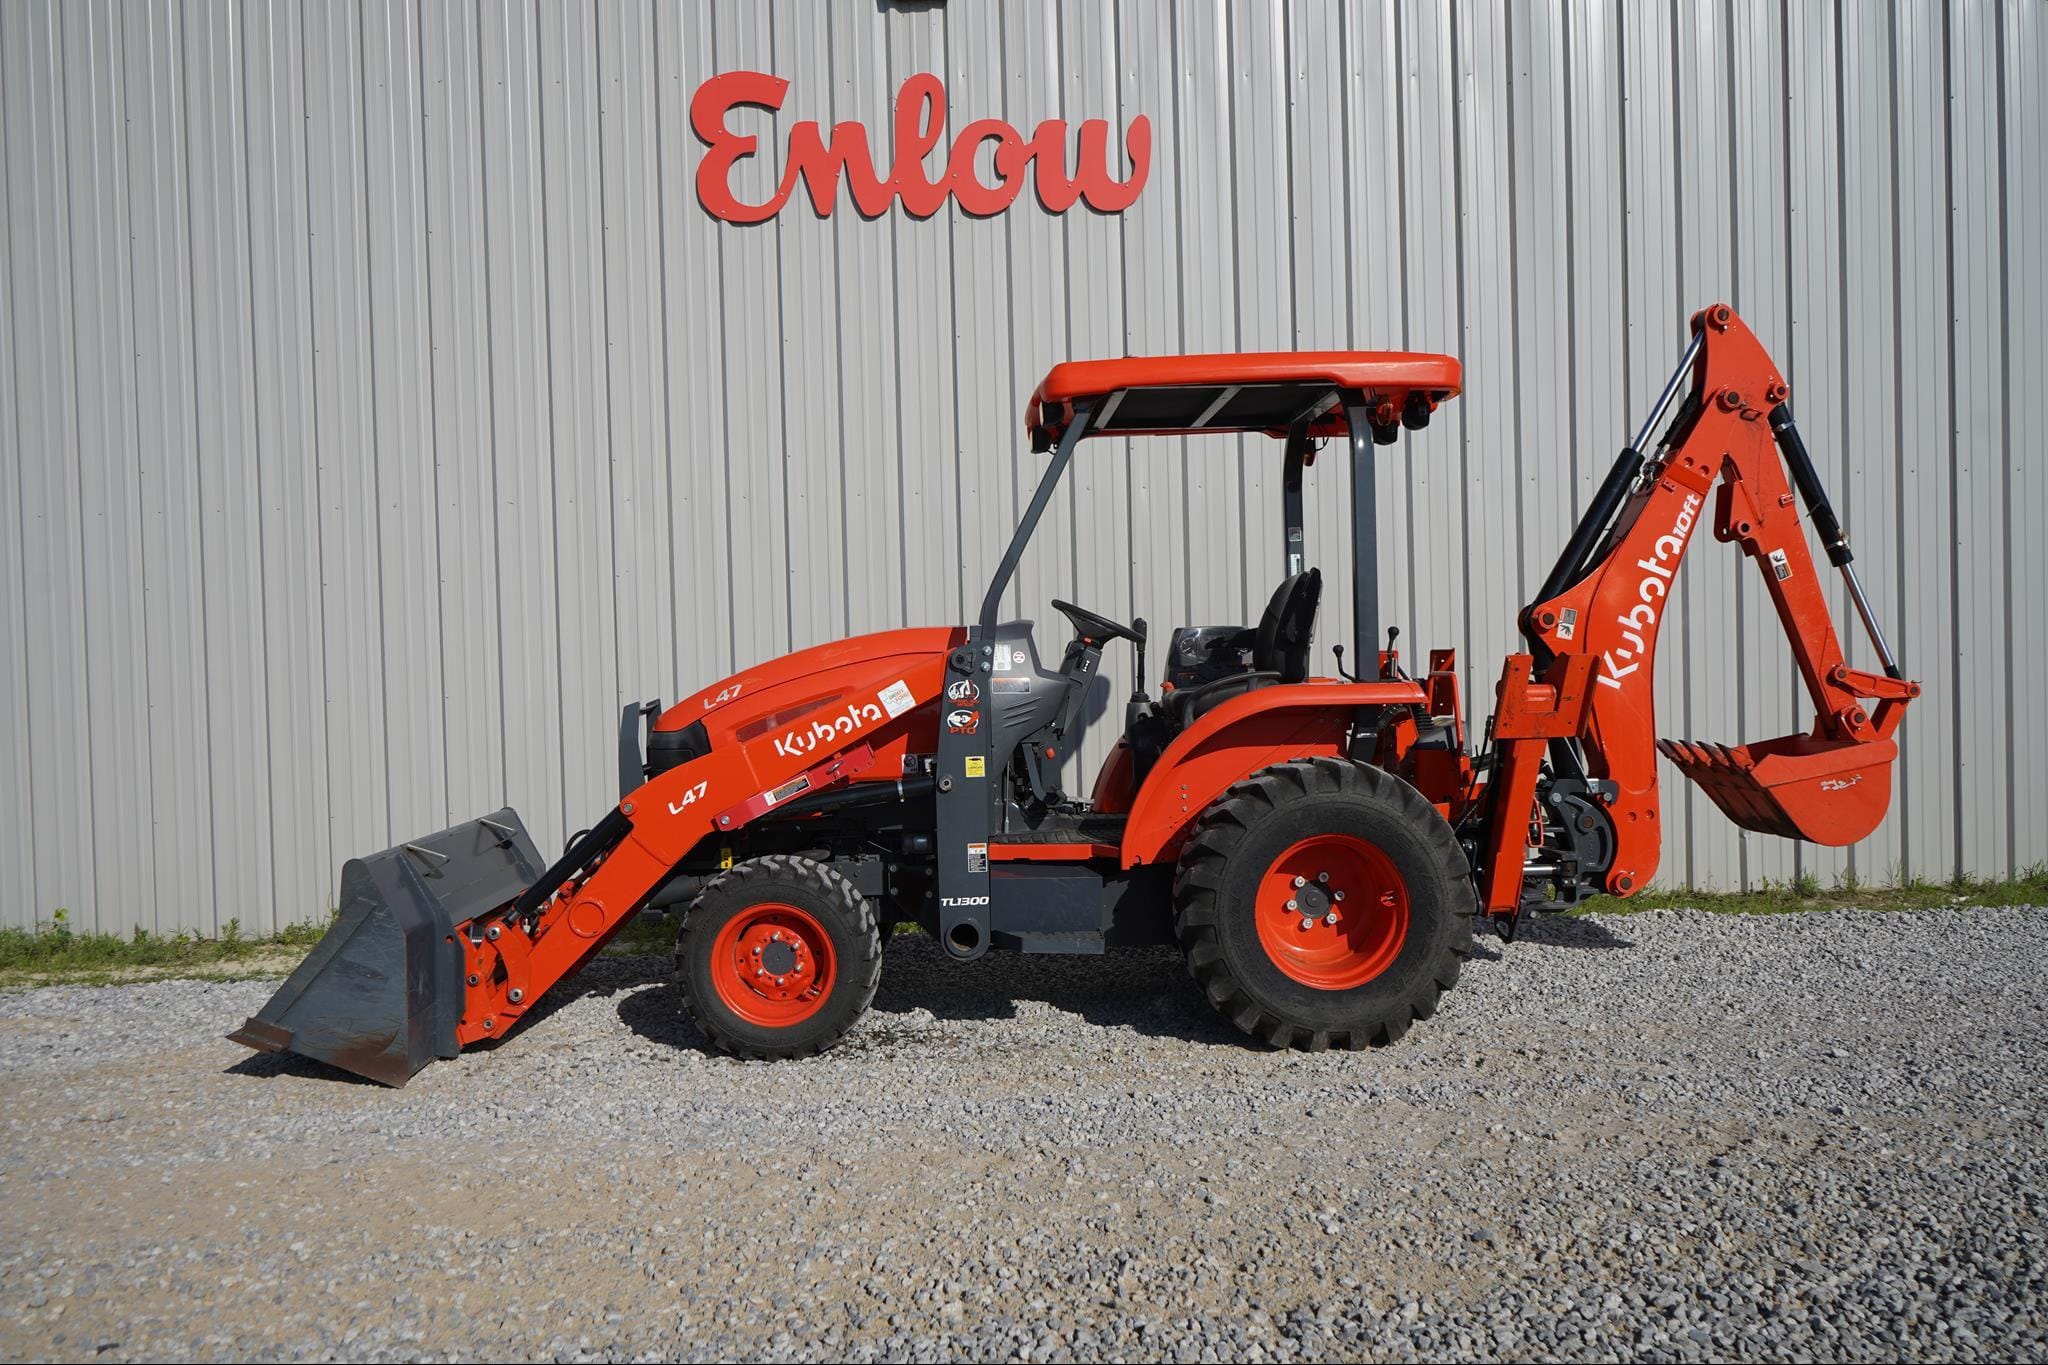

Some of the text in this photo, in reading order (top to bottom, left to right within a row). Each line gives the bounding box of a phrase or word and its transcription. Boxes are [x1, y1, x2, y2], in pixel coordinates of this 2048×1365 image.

[690, 71, 1151, 223] Enlow
[1597, 493, 1700, 689] Kubota 10ft
[703, 683, 742, 709] L47
[773, 703, 882, 756] Kubota
[949, 726, 976, 735] PTO
[668, 780, 707, 815] L47
[940, 896, 990, 907] TL1300
